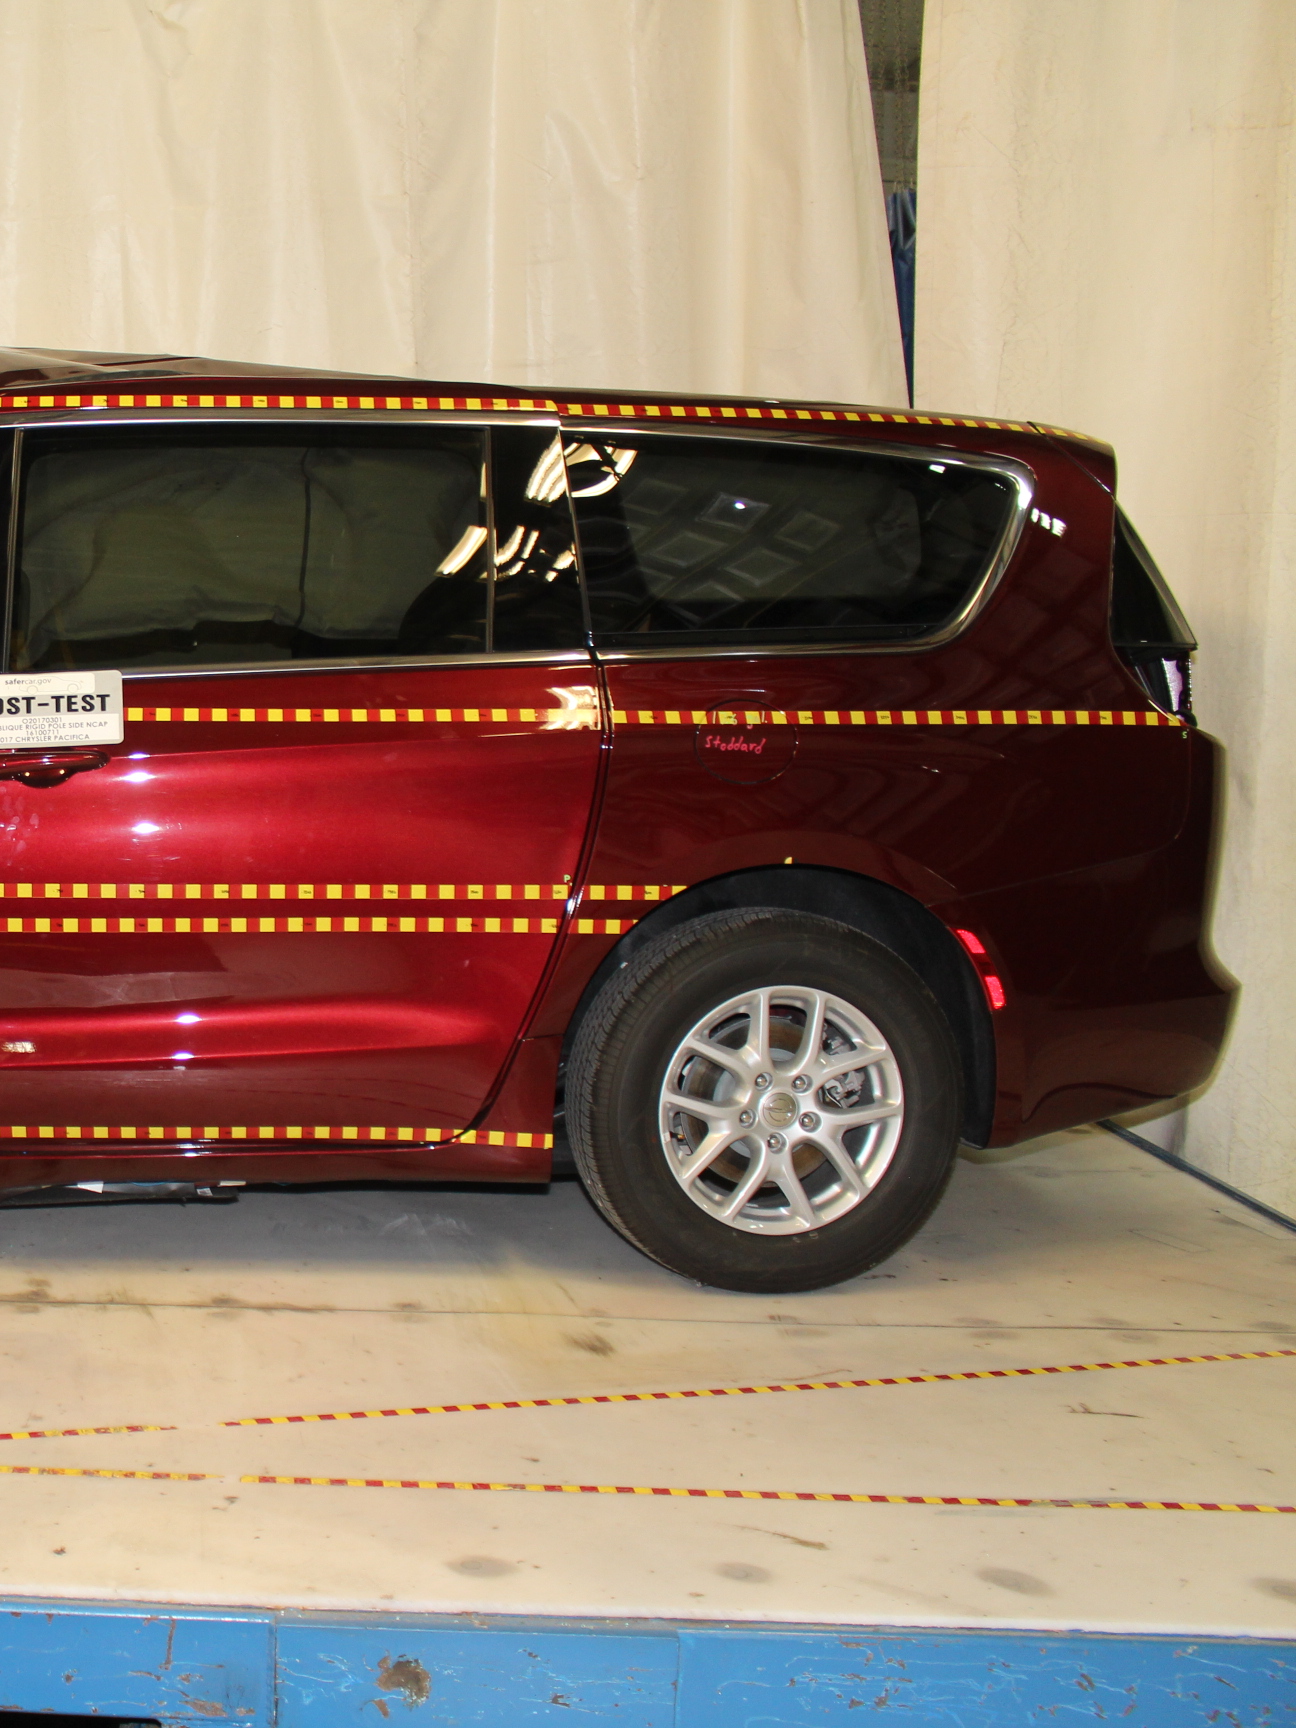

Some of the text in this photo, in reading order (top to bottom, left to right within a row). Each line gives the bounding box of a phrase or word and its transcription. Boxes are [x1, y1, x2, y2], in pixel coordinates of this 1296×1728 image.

[5, 677, 52, 686] safercar.gov
[48, 722, 66, 730] POLE
[68, 721, 84, 729] SIDE
[86, 720, 108, 728] NCAP
[15, 735, 52, 743] CHRYSLER
[54, 733, 90, 741] PACIFICA
